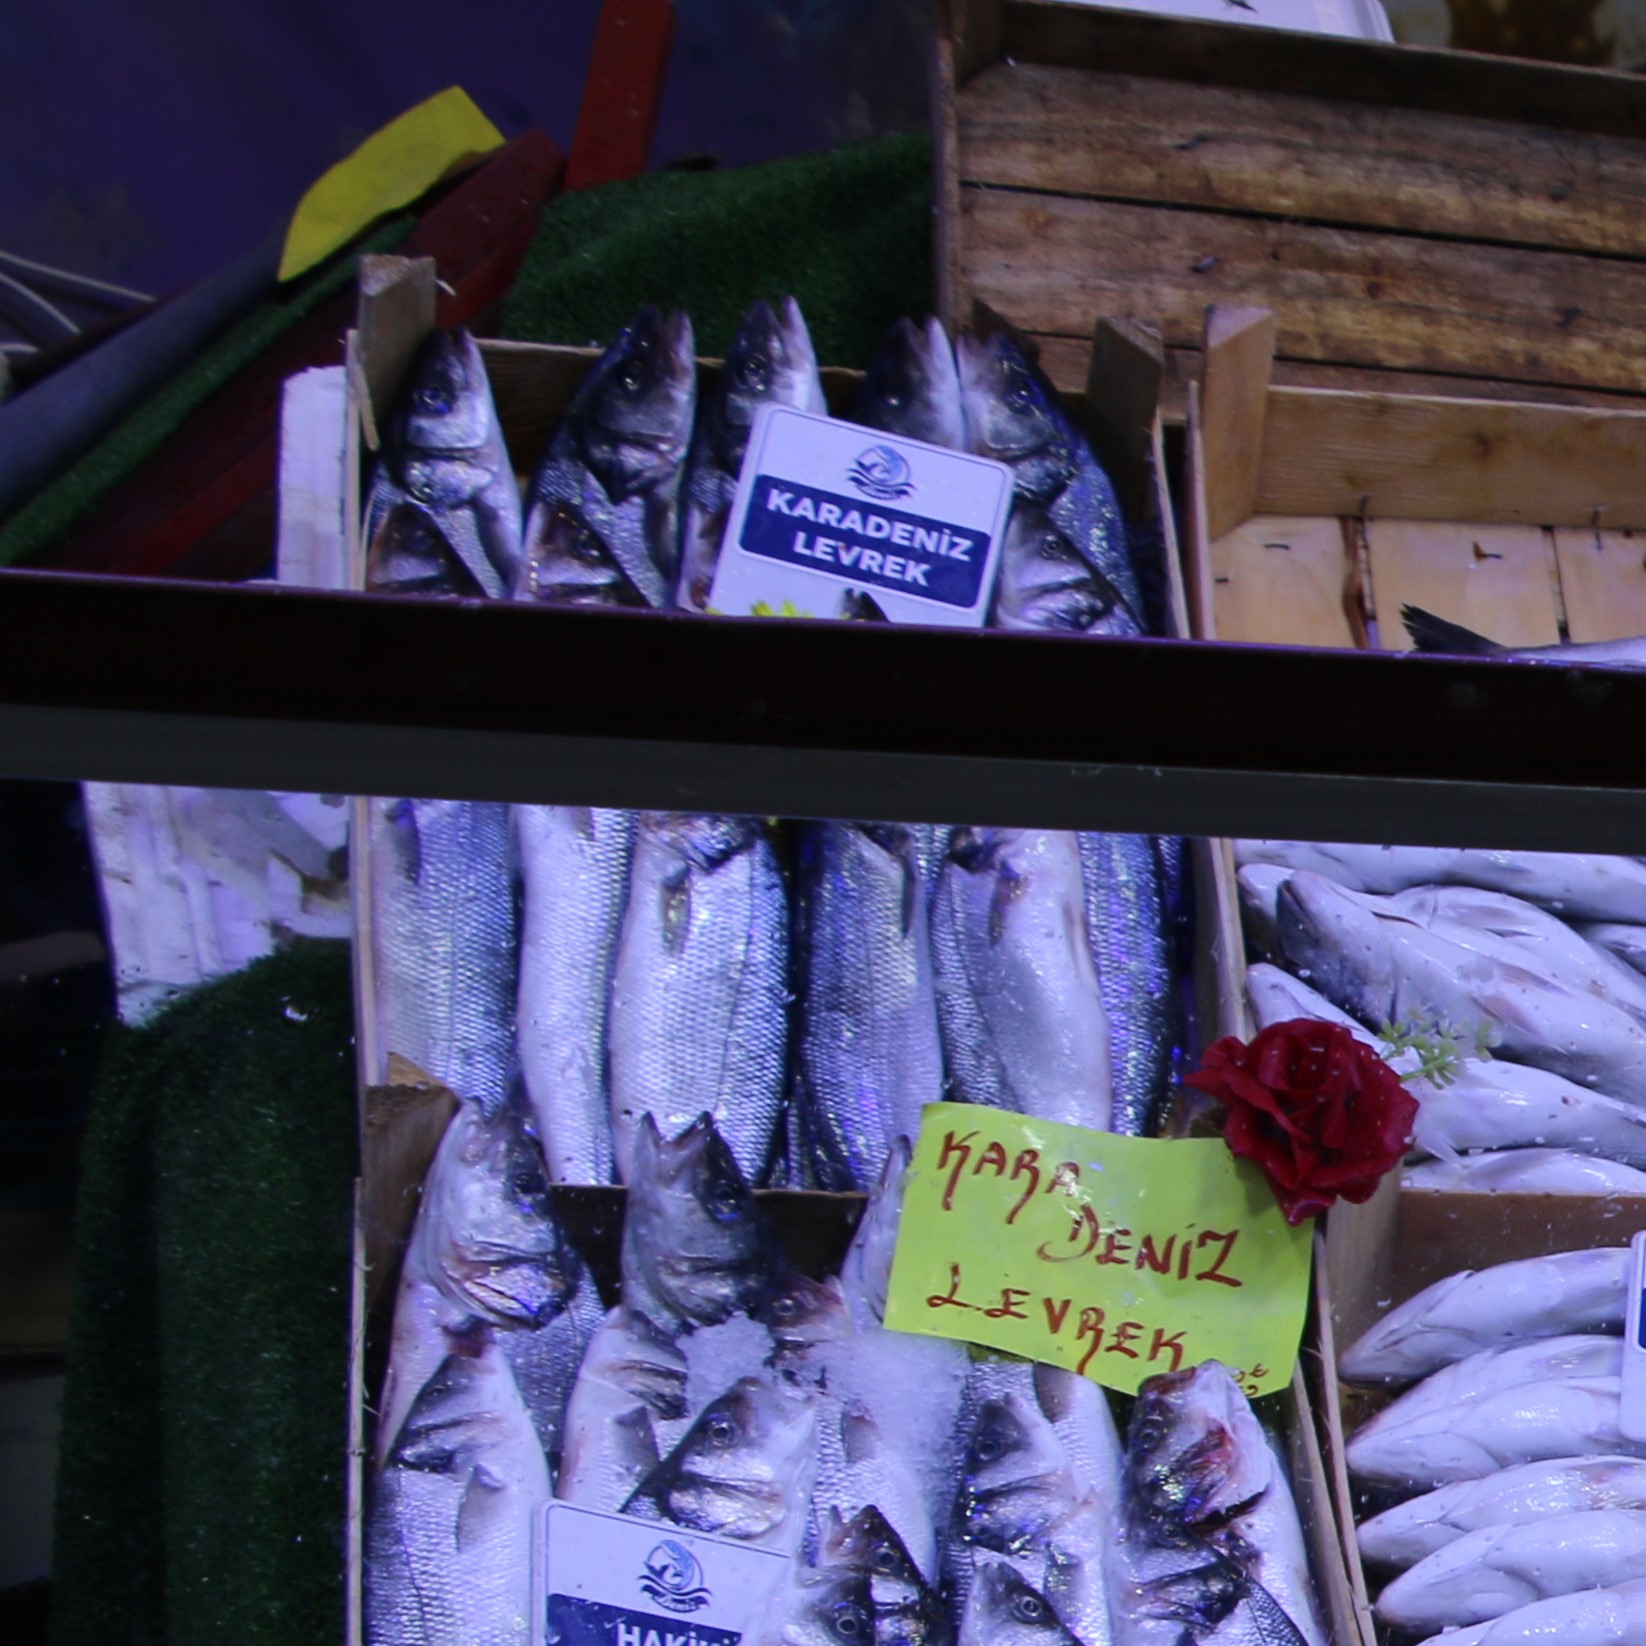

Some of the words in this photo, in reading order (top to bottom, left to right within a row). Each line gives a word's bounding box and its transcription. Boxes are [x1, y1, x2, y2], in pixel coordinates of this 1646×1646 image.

[765, 488, 975, 562] KARADENİZ
[792, 531, 933, 587] LEVREK
[936, 1130, 1081, 1225] KARA
[1037, 1204, 1243, 1288] DENİZ
[926, 1262, 1188, 1375] LEVREK
